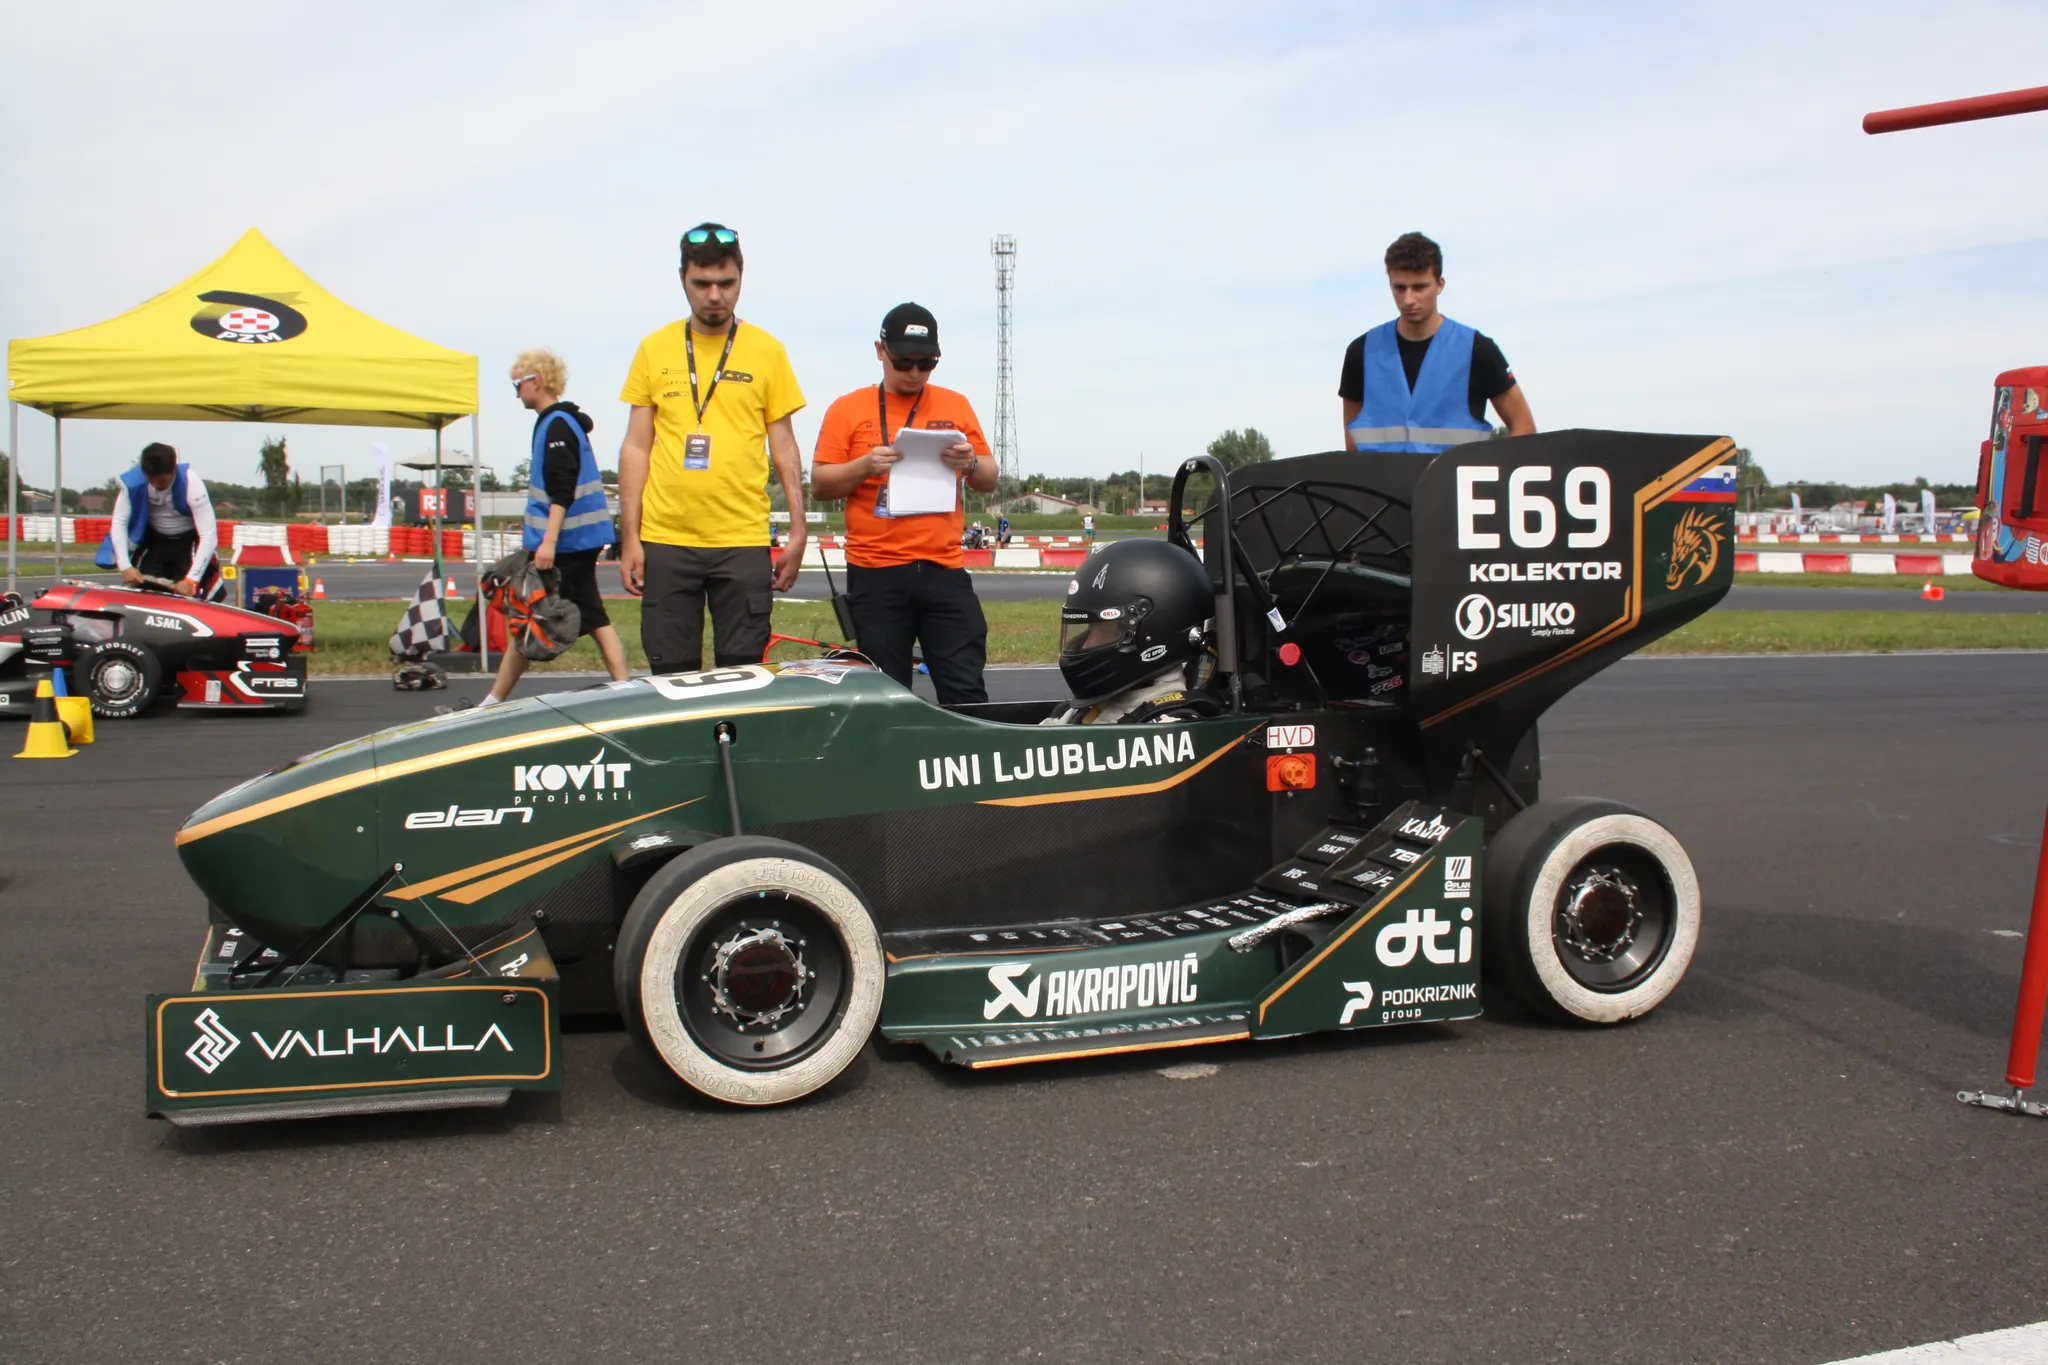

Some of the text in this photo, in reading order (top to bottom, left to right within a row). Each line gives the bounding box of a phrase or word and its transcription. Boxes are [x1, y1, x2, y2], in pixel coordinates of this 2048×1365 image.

[216, 331, 282, 343] PZM
[1457, 466, 1611, 549] E69
[1469, 562, 1622, 582] KOLEKTOR
[145, 615, 183, 630] ASML
[1496, 602, 1576, 628] SILIKO
[1531, 629, 1552, 637] Simply
[1452, 652, 1477, 672] FS
[251, 678, 298, 687] FT26
[1269, 727, 1314, 747] HVD
[919, 731, 1195, 789] UNI LJUBLJANA
[514, 790, 631, 805] projekti
[405, 805, 534, 829] elan
[1375, 907, 1473, 967] dti
[1046, 952, 1198, 1016] AKRAPOVIČ
[1382, 983, 1476, 1006] PODKRIZNIK
[1382, 1008, 1422, 1023] group
[251, 1023, 514, 1060] VALHALLA
